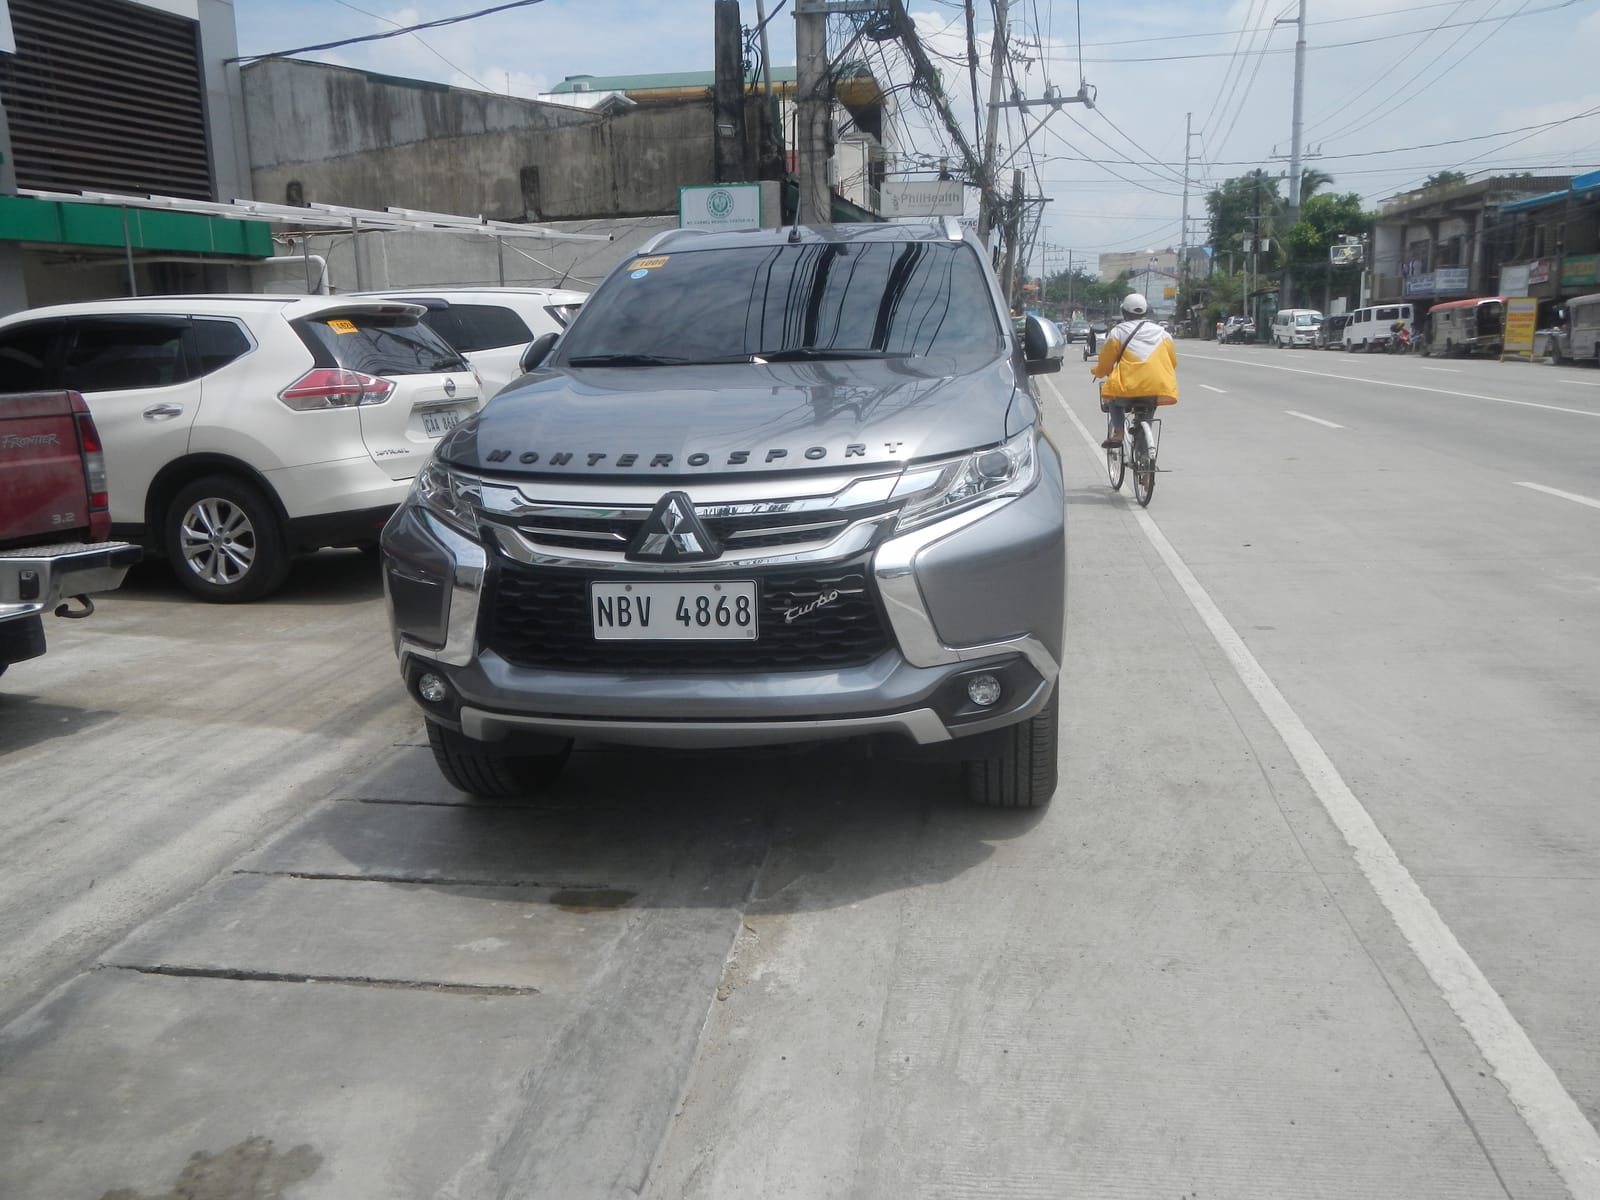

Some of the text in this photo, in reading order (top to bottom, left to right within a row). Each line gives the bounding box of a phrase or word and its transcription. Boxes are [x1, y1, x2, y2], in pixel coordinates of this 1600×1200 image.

[51, 512, 75, 525] 3.2
[597, 594, 752, 627] NBV 4868
